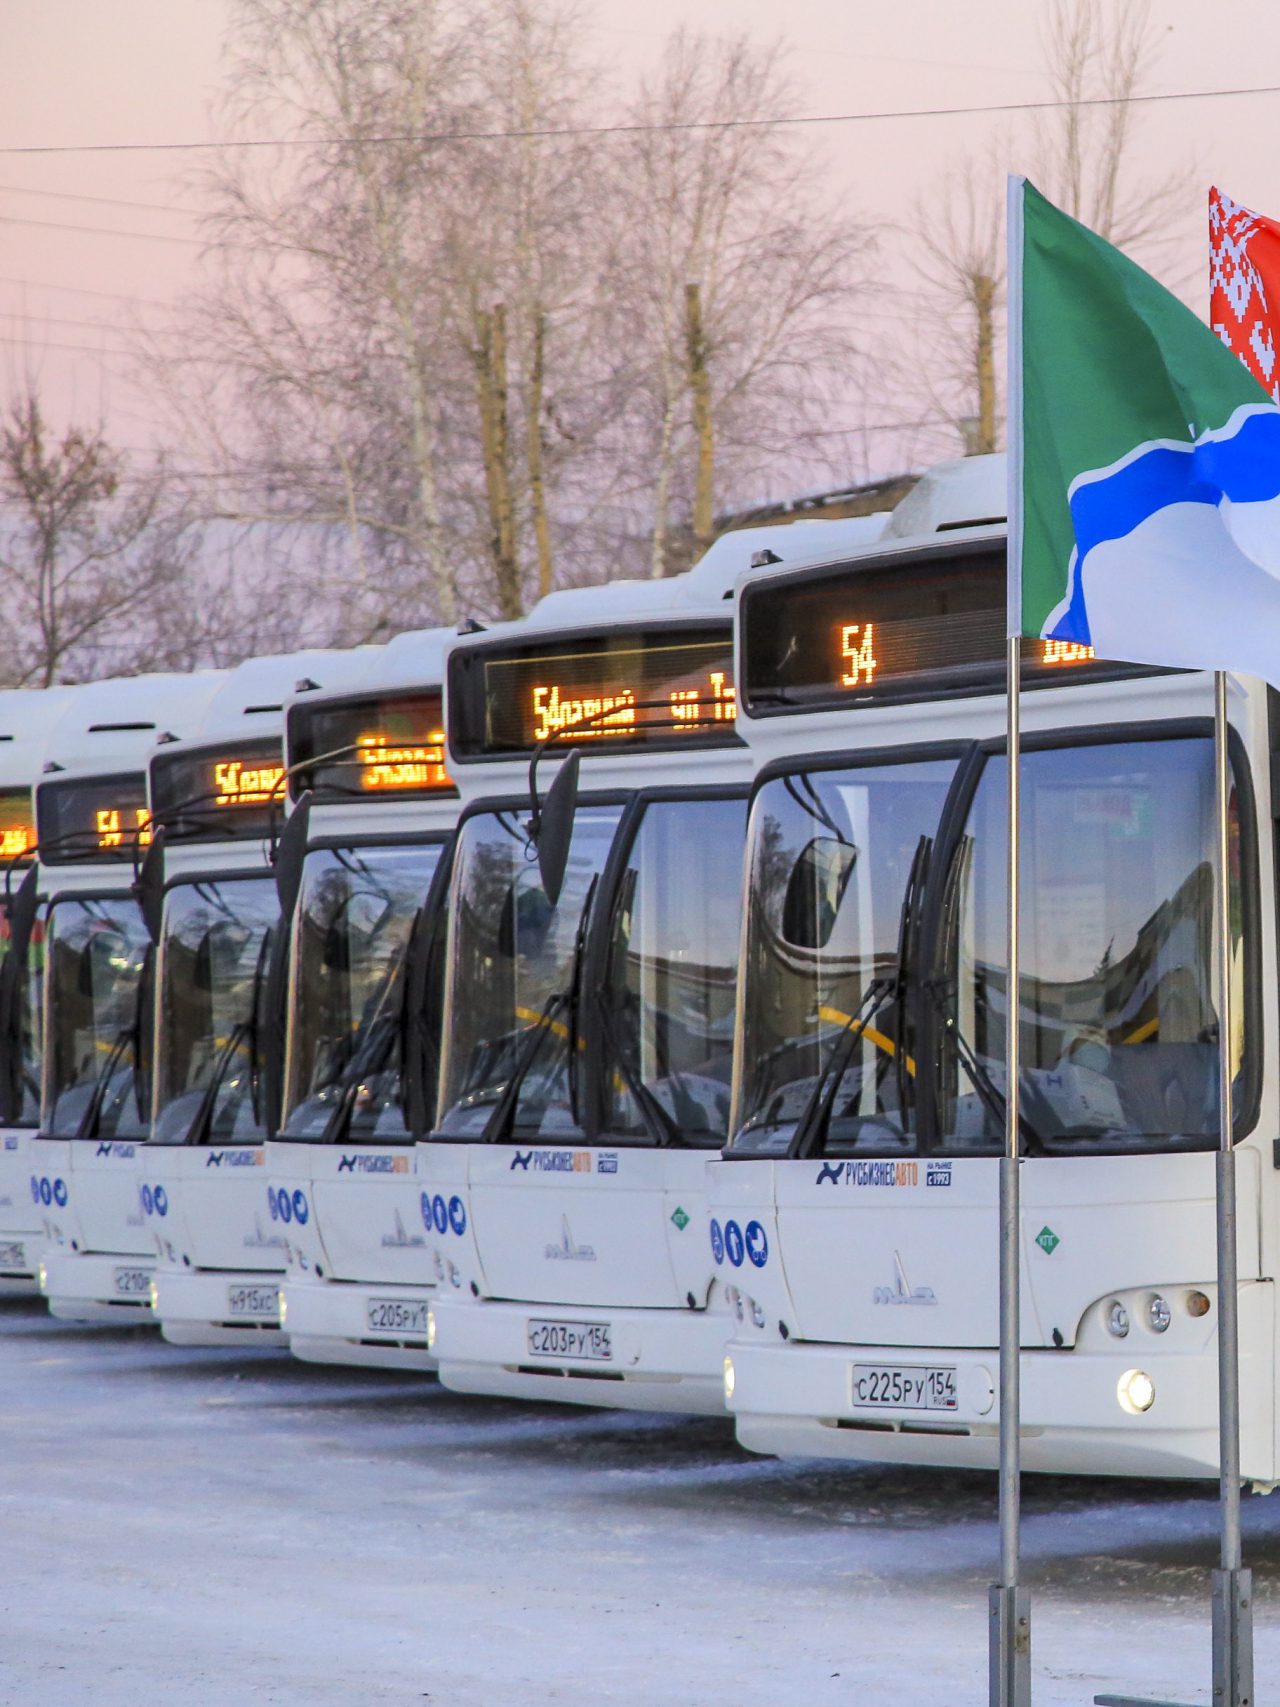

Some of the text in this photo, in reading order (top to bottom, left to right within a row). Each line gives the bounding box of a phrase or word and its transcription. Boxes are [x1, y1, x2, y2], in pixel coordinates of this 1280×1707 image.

[842, 623, 877, 686] 54
[846, 1162, 918, 1186] РУСБИЗНЕСАВТО
[532, 1326, 585, 1353] С203РУ
[858, 1372, 953, 1403] С225РУ 154
